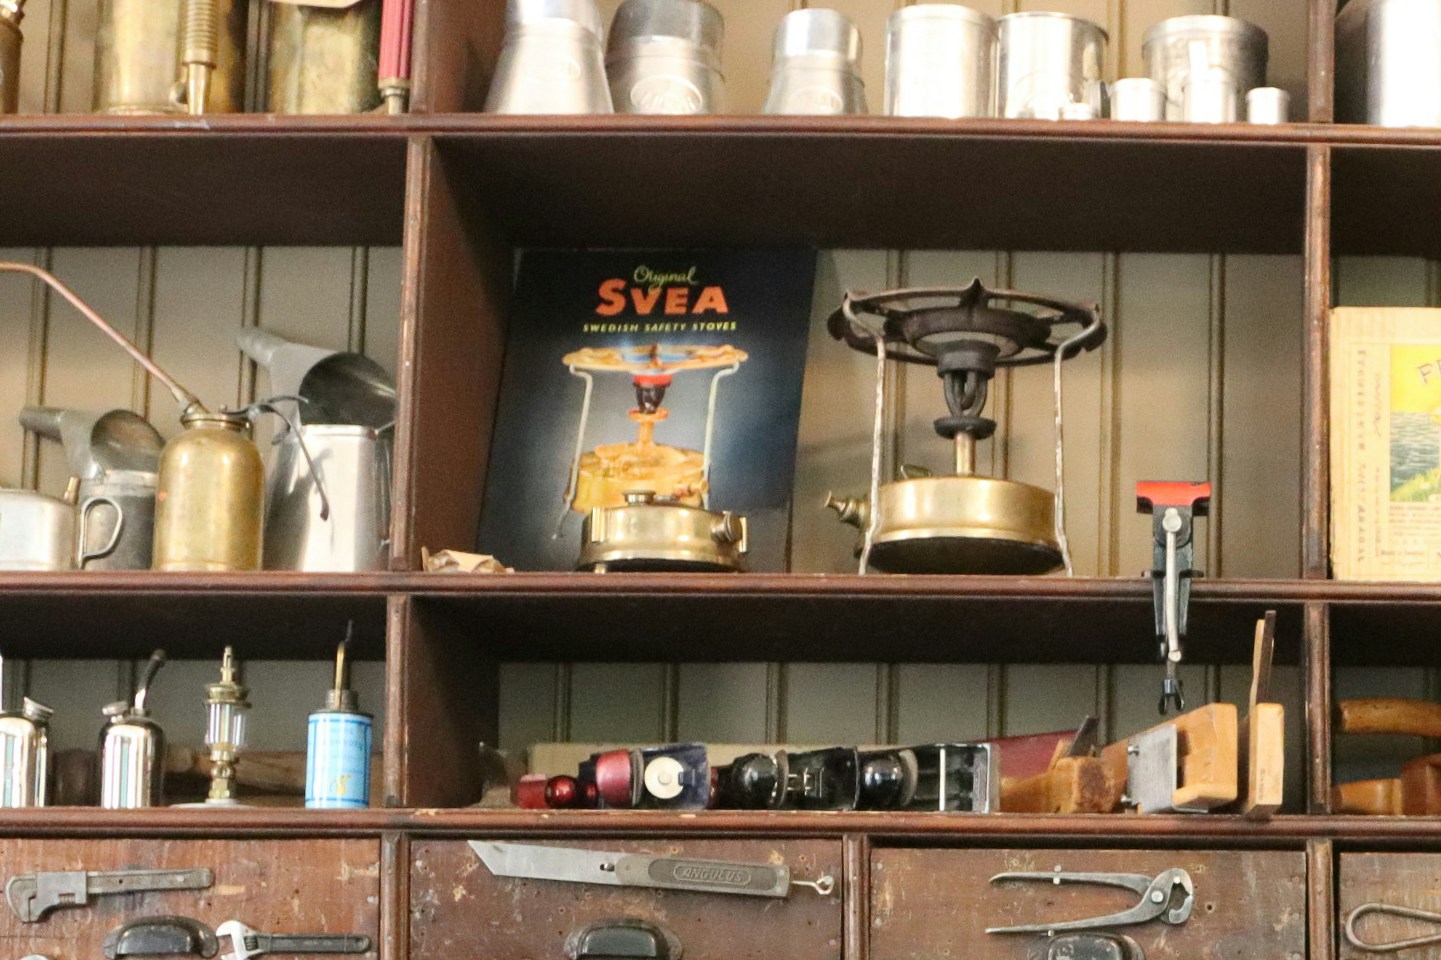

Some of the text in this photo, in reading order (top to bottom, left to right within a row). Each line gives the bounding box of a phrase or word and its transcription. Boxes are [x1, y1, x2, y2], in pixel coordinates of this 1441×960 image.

[633, 265, 700, 292] Original
[595, 278, 729, 316] SVEA
[583, 321, 737, 333] SWEDISH SAFETY STOVES
[681, 867, 743, 882] ANGULUS
